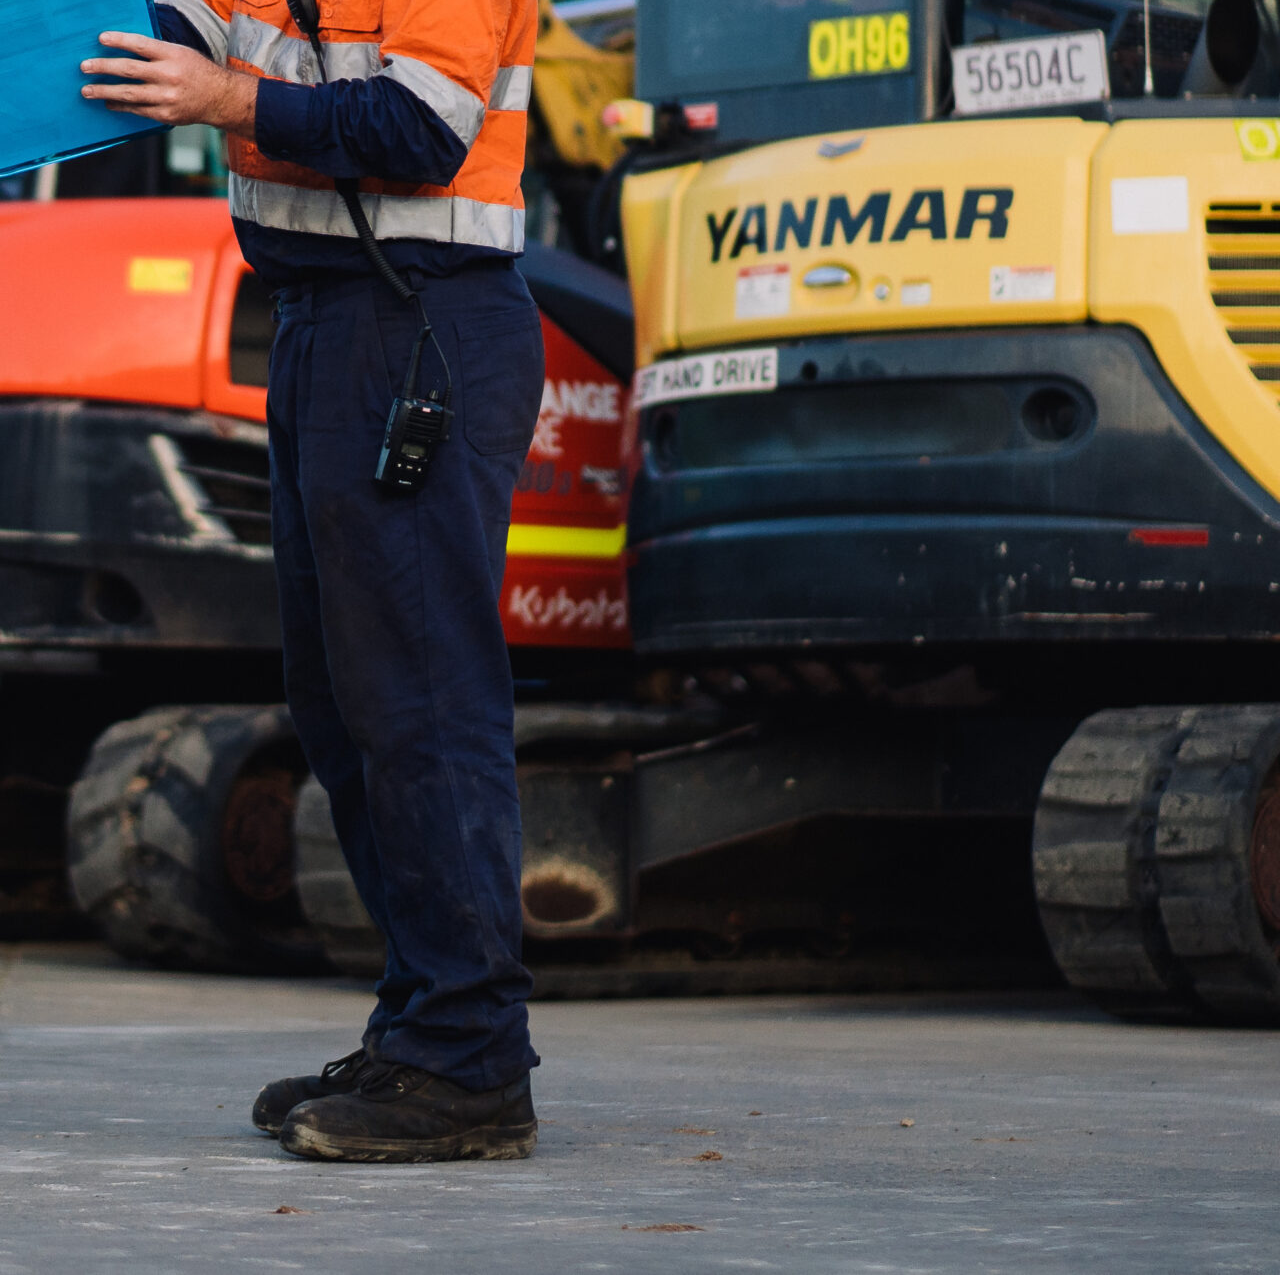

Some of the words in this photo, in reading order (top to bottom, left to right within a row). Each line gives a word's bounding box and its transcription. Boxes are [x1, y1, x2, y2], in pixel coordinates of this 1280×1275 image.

[807, 12, 910, 79] OH96
[965, 42, 1087, 96] 56504C
[705, 186, 1015, 264] YANMAR
[663, 361, 705, 392] HAND
[712, 355, 772, 387] DRIVE
[509, 584, 627, 629] Kubota
